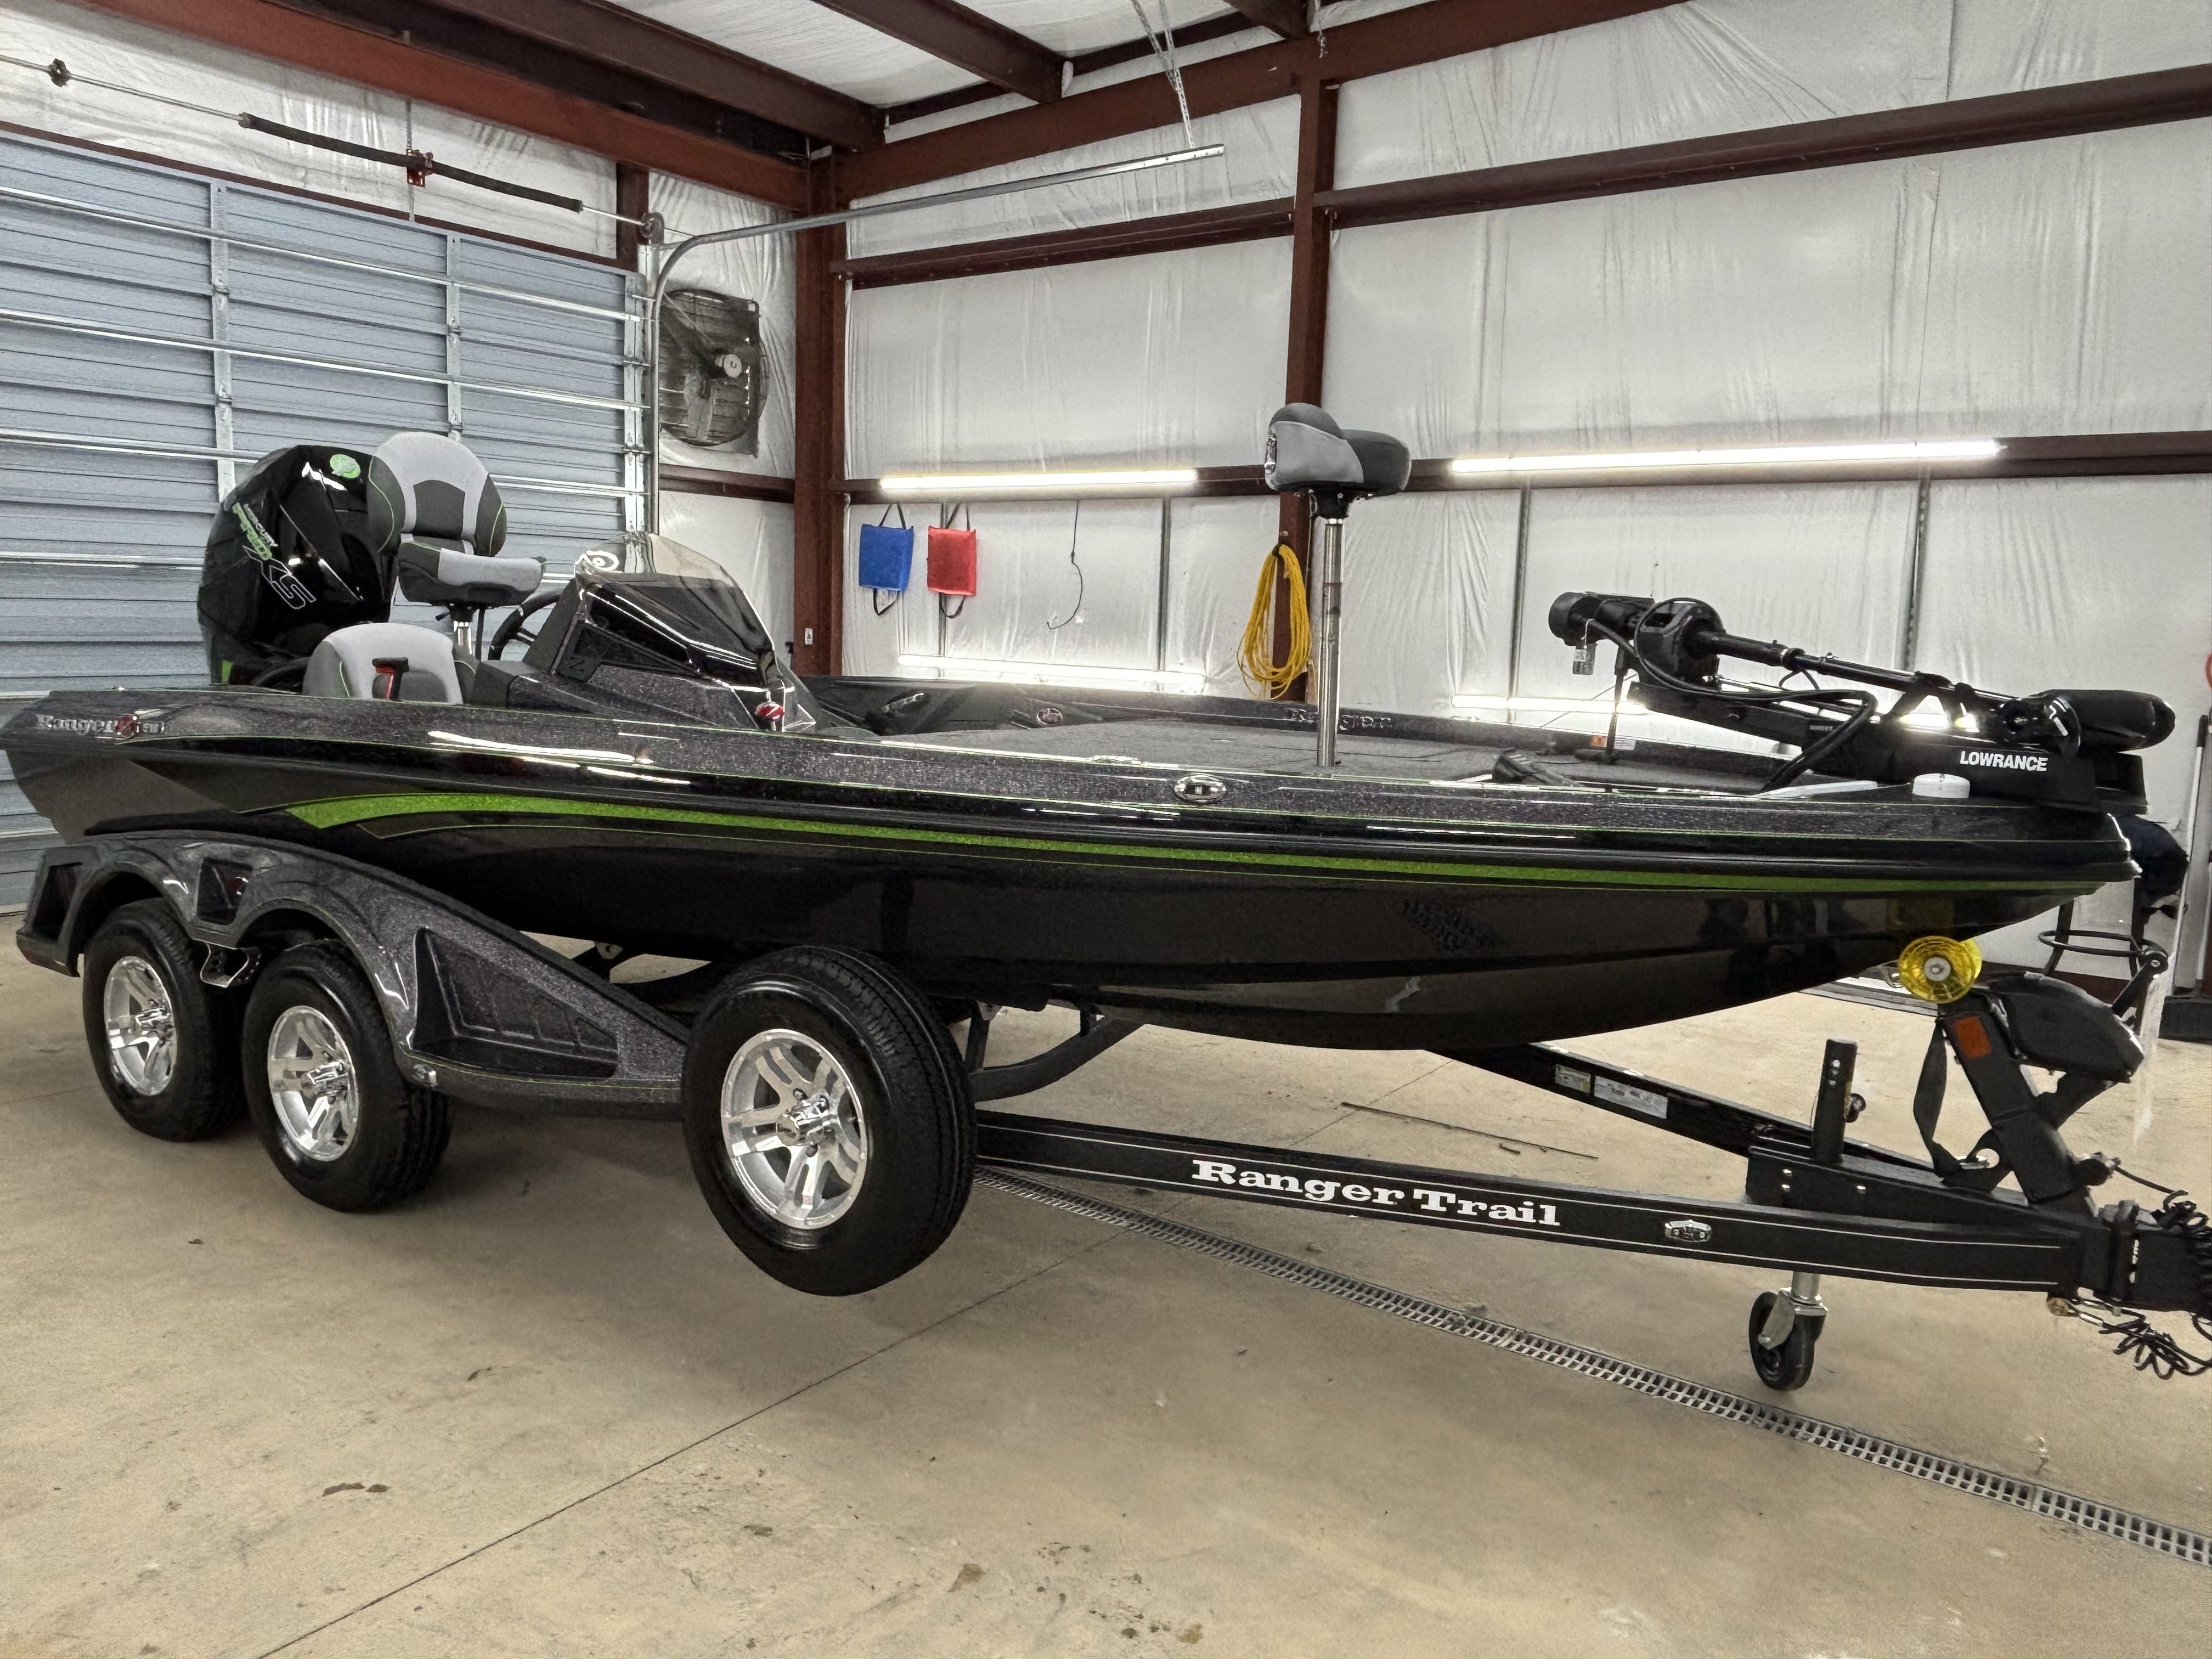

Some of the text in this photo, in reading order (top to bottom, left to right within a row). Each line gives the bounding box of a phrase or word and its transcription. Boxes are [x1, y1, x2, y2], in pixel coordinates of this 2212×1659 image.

[1960, 751, 2049, 772] LOWRANCE
[1192, 1159, 1560, 1226] Ranger Trail
